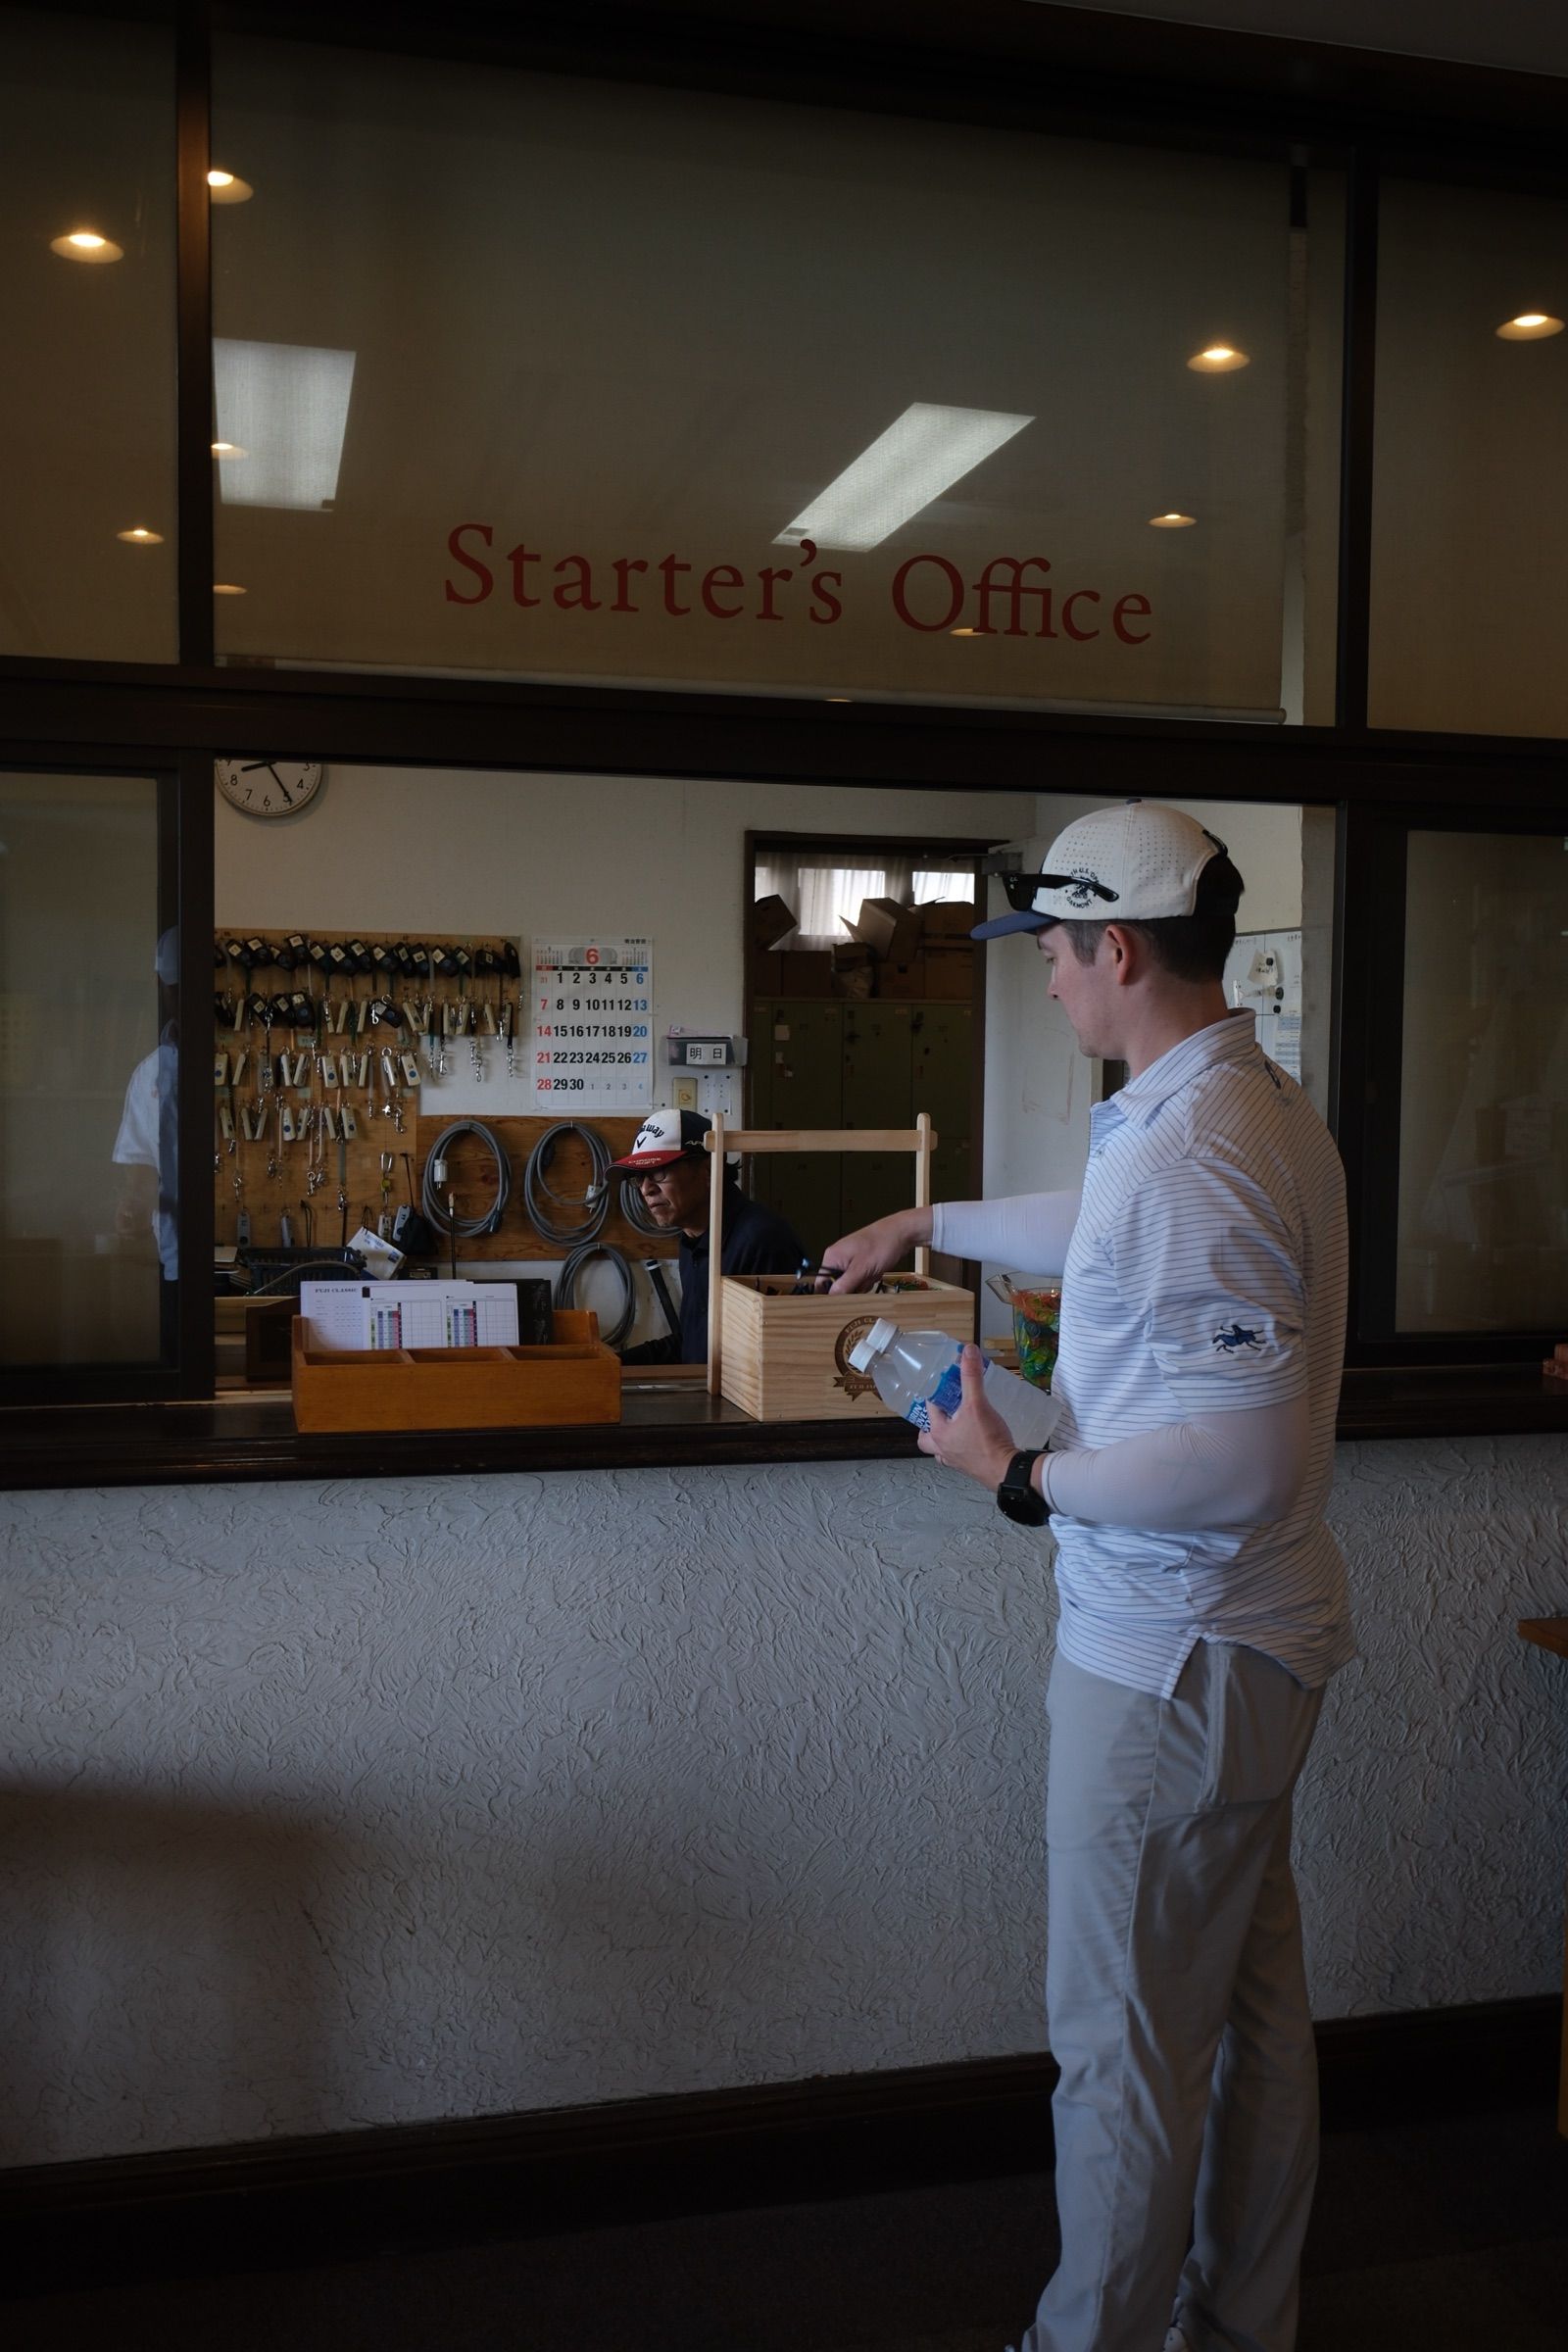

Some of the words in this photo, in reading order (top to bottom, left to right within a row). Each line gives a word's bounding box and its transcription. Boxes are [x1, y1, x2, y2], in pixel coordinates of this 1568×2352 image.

[445, 522, 843, 624] Starter's
[891, 554, 1152, 645] Office
[229, 774, 238, 786] 8
[296, 778, 304, 789] 4
[245, 789, 253, 802] 7
[263, 795, 271, 807] 6
[586, 948, 599, 965] 6
[558, 972, 563, 984] 1
[572, 972, 581, 984] 2
[589, 972, 597, 984] 3
[605, 973, 612, 984] 4
[620, 972, 628, 984] 5
[636, 972, 644, 984] 6
[540, 999, 548, 1010] 7
[557, 999, 564, 1010] 8
[572, 999, 580, 1010] 9
[586, 999, 600, 1010] 10
[602, 1000, 614, 1010] 11
[618, 1000, 632, 1010] 12
[633, 1000, 648, 1010] 13
[537, 1025, 552, 1037] 14
[554, 1025, 567, 1037] 15
[570, 1025, 584, 1037] 16
[586, 1026, 600, 1037] 17
[602, 1026, 616, 1037] 18
[617, 1026, 632, 1037] 19
[633, 1026, 648, 1038] 20
[537, 1053, 551, 1063] 21
[554, 1053, 567, 1064] 22
[569, 1053, 584, 1064] 23
[586, 1053, 600, 1064] 24
[602, 1053, 615, 1064] 25
[617, 1053, 632, 1064] 26
[633, 1053, 647, 1064] 27
[689, 1048, 722, 1059] 明日
[537, 1079, 552, 1091] 28
[554, 1079, 567, 1091] 29
[569, 1079, 584, 1091] 30
